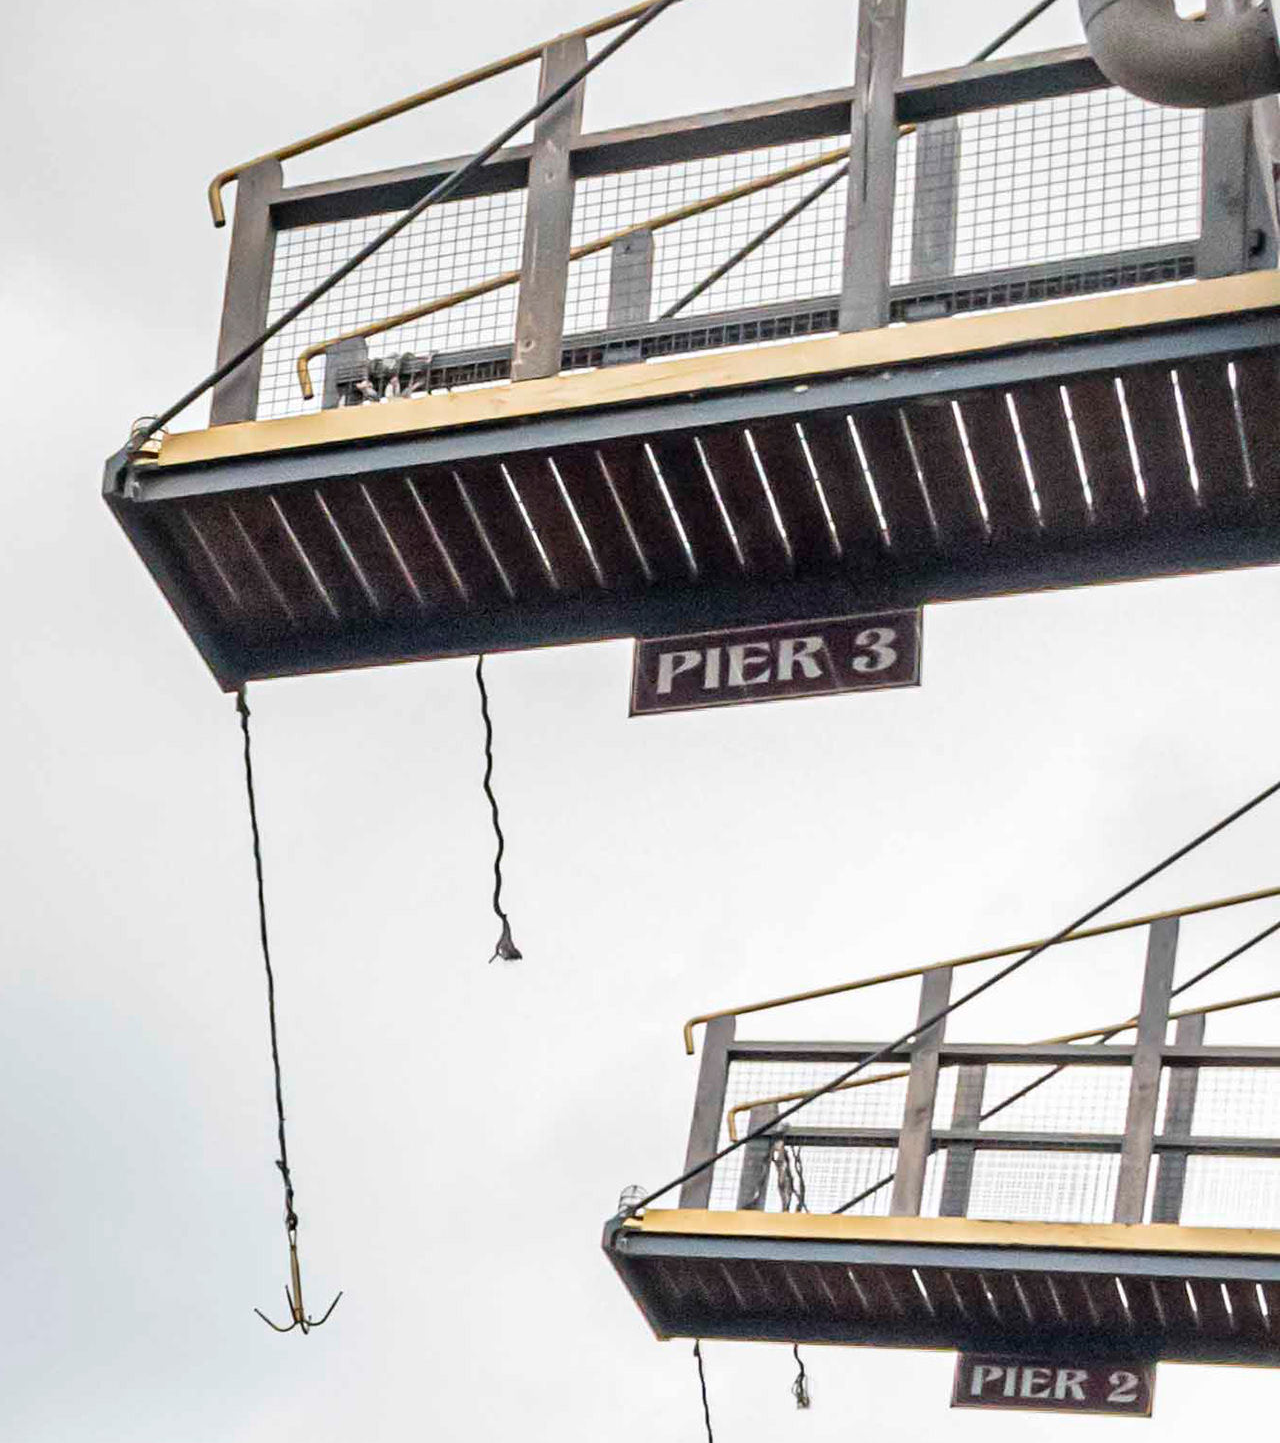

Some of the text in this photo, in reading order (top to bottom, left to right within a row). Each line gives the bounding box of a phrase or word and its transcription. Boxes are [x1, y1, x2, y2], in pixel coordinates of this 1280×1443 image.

[656, 627, 897, 695] PIER 3
[970, 1365, 1139, 1403] PIER 2
